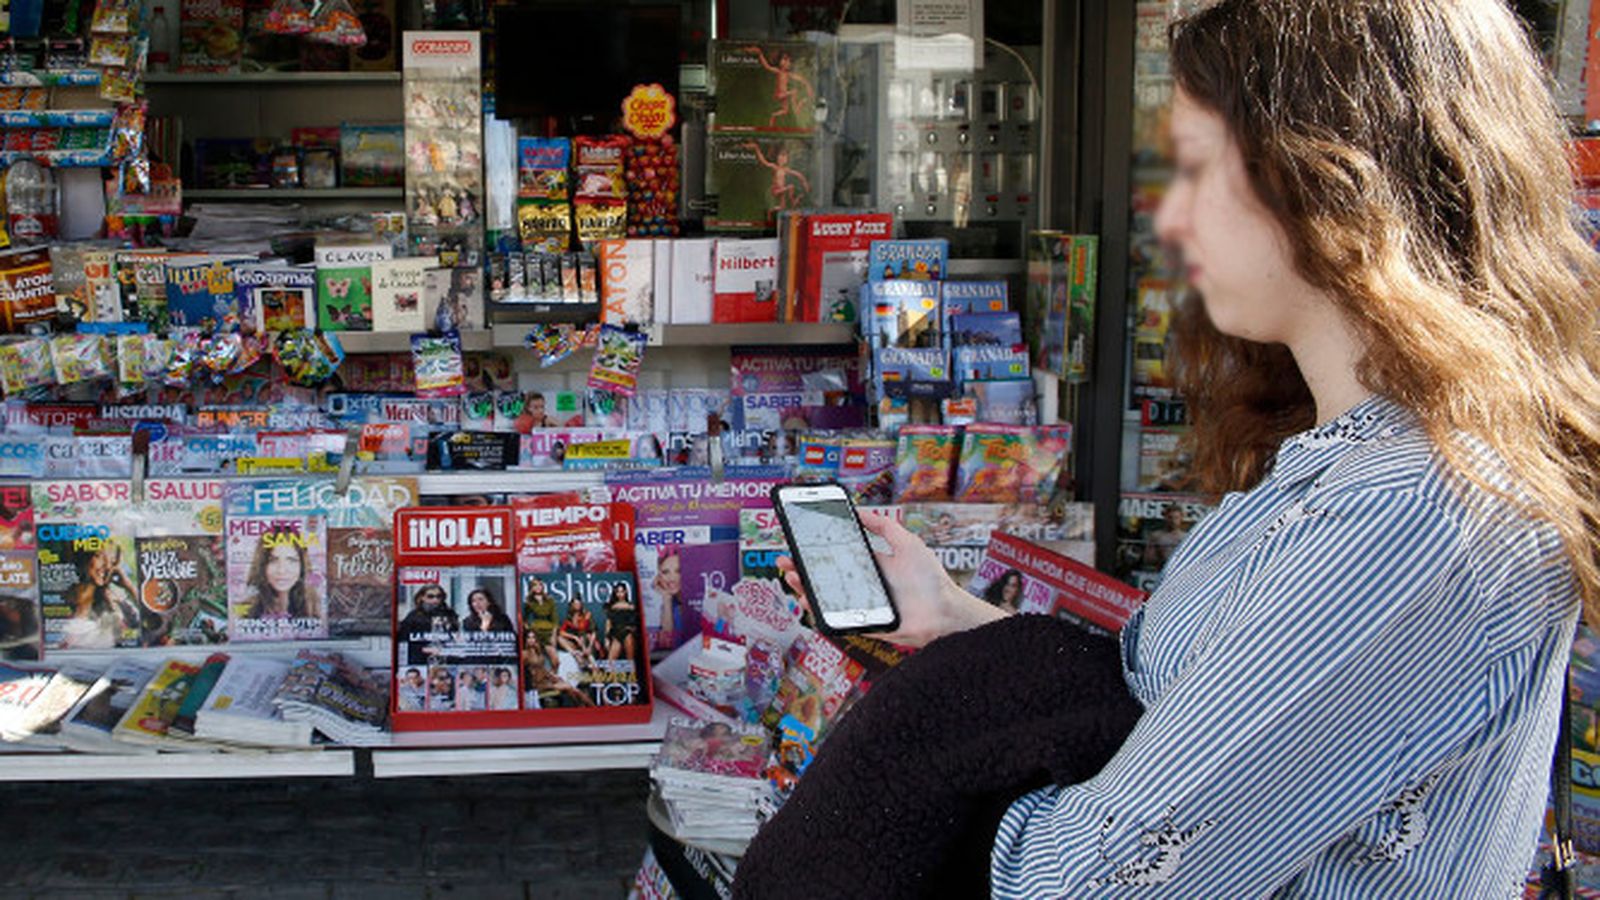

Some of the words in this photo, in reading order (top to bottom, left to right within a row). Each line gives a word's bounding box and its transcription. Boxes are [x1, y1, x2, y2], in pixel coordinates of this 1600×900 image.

[522, 216, 567, 230] HARIBO
[876, 242, 943, 261] GRANADA
[871, 280, 936, 297] GRANADA
[943, 282, 1003, 298] GRANADA
[880, 350, 945, 366] GRANADA
[746, 395, 802, 409] SABER
[102, 404, 183, 423] HISTORIA
[47, 483, 128, 503] SABOR
[149, 481, 223, 501] SALUD
[615, 485, 677, 503] ACTIVA
[678, 483, 702, 500] TU
[705, 481, 779, 498] MEMOR
[515, 505, 606, 528] TIEMPO
[37, 524, 111, 542] CUERPO
[229, 518, 303, 537] MENTE
[408, 516, 503, 549] ¡HOLA!
[263, 531, 319, 549] SANA
[591, 683, 639, 706] TOP
